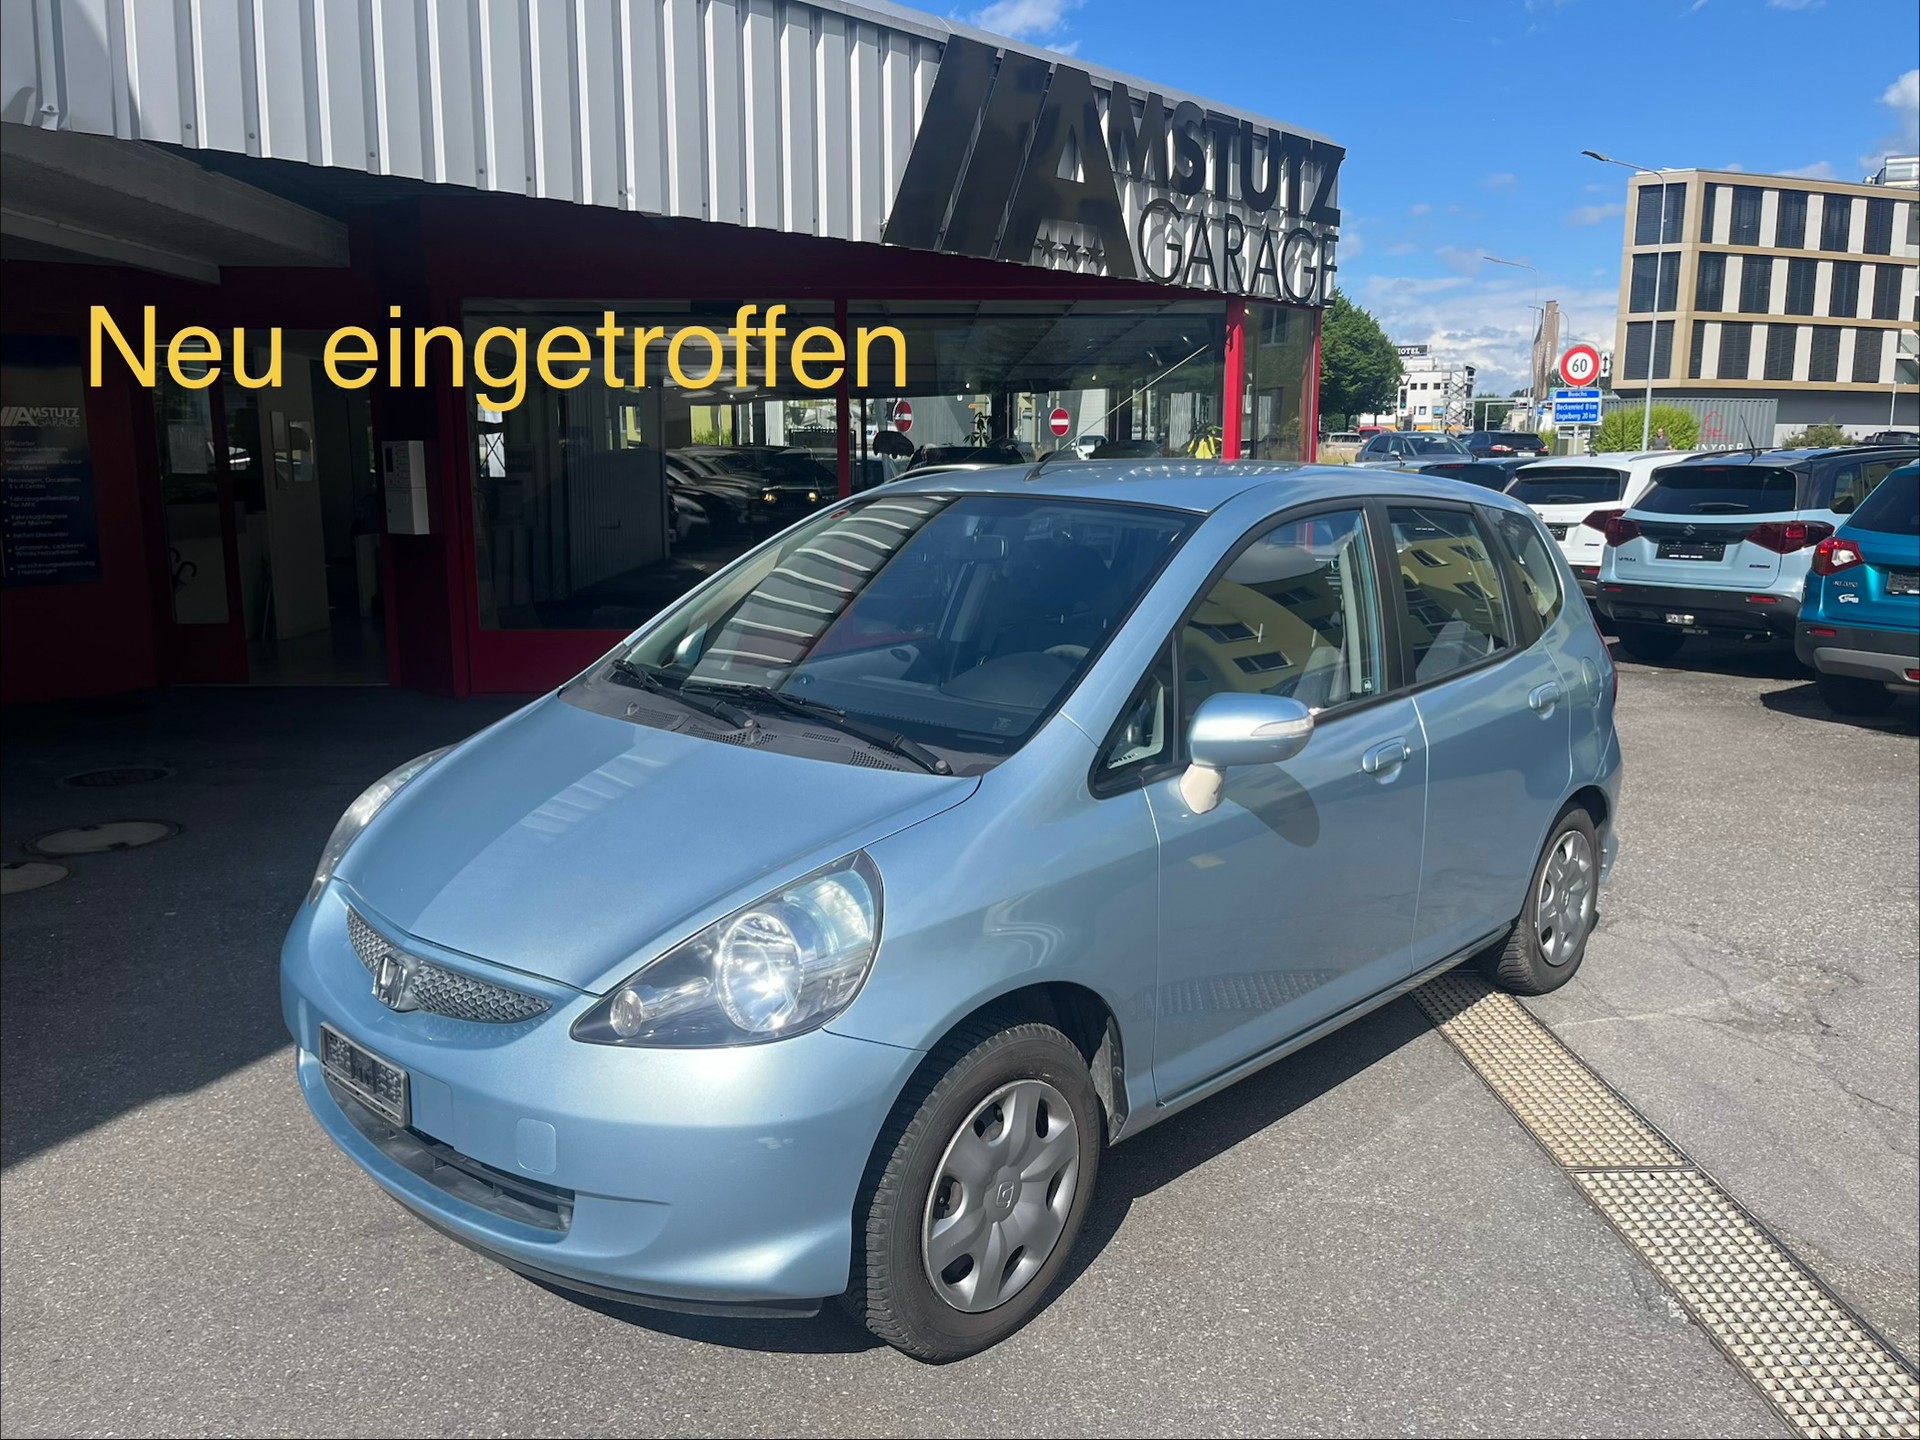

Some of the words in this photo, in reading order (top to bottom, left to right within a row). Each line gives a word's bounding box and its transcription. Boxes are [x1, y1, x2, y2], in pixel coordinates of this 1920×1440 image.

[996, 63, 1346, 278] AMSTUTZ
[1137, 198, 1339, 307] GARAGE
[1572, 358, 1588, 373] 60
[1556, 403, 1584, 411] Beckenried
[13, 406, 80, 426] AMSTUTZ
[36, 417, 80, 427] GARAGE
[1556, 412, 1581, 421] Engelberg
